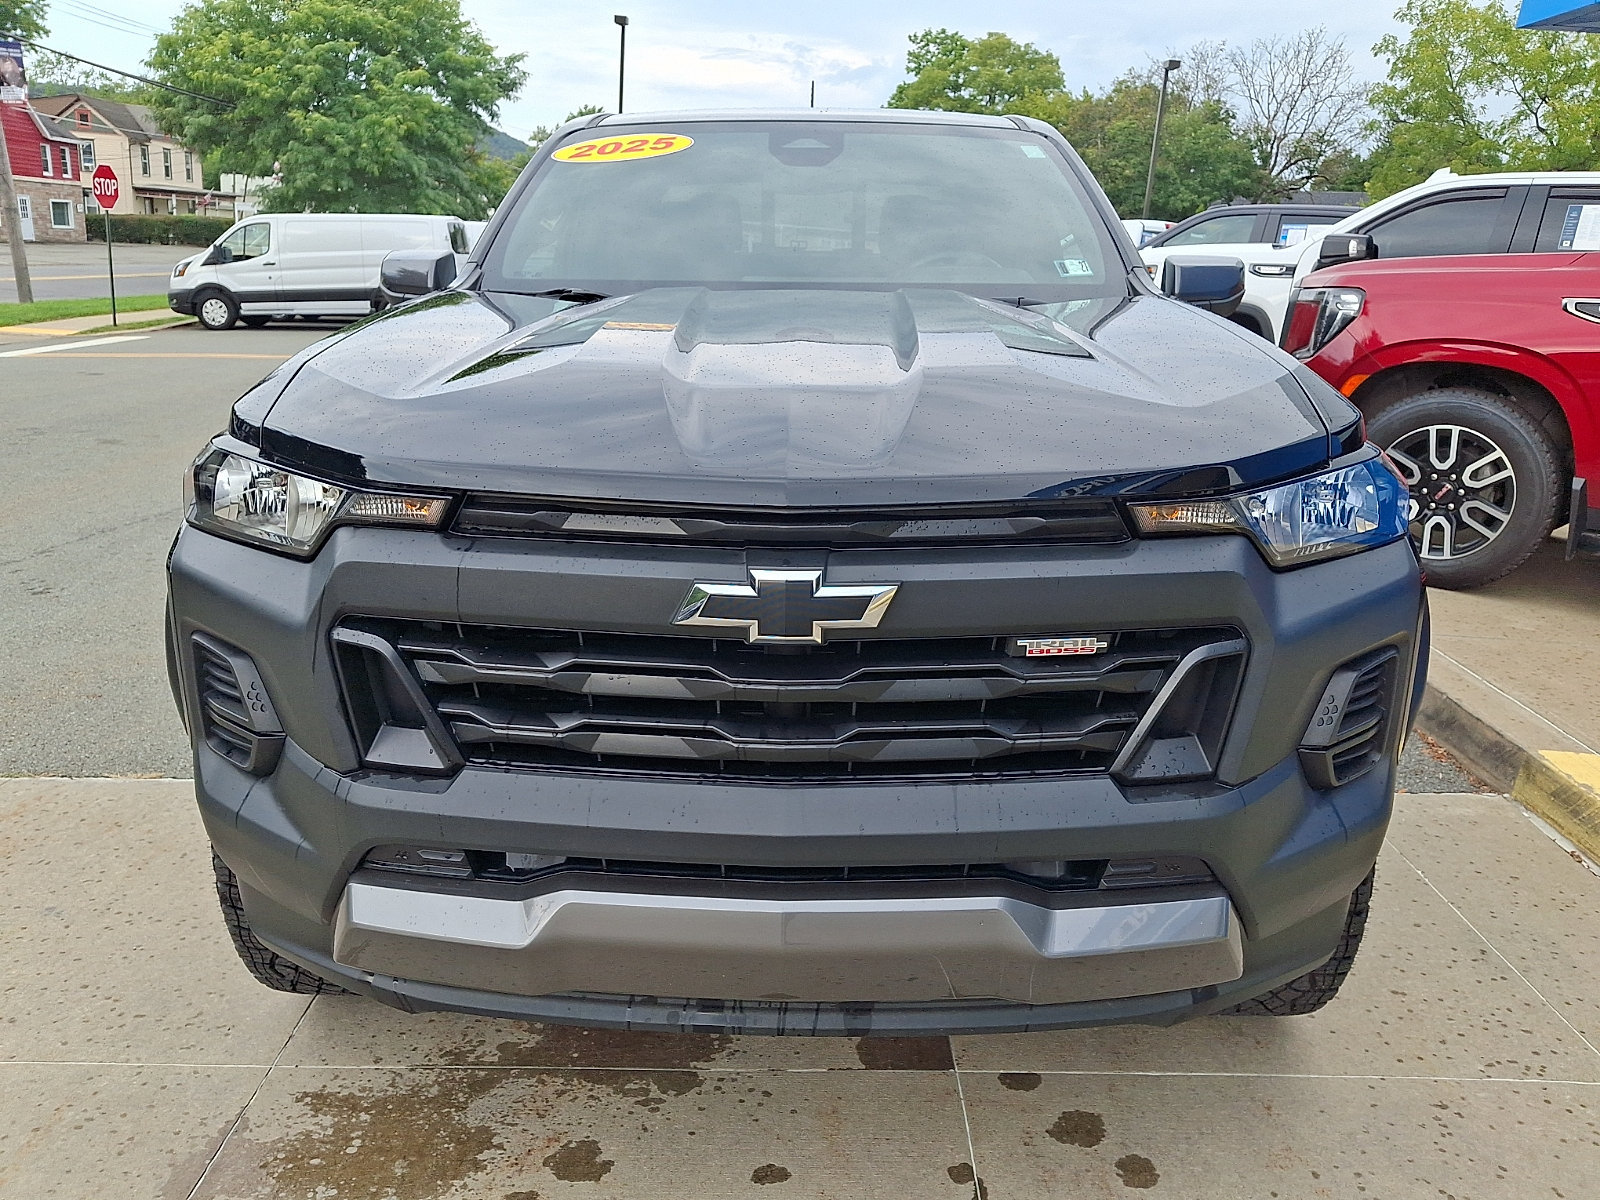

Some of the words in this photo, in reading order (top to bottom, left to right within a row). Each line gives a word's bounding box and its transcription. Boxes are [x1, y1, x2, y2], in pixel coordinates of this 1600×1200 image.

[568, 136, 677, 159] 2025
[94, 177, 118, 196] STOP
[1017, 638, 1107, 649] TRAIL
[1027, 646, 1096, 655] BOSS
